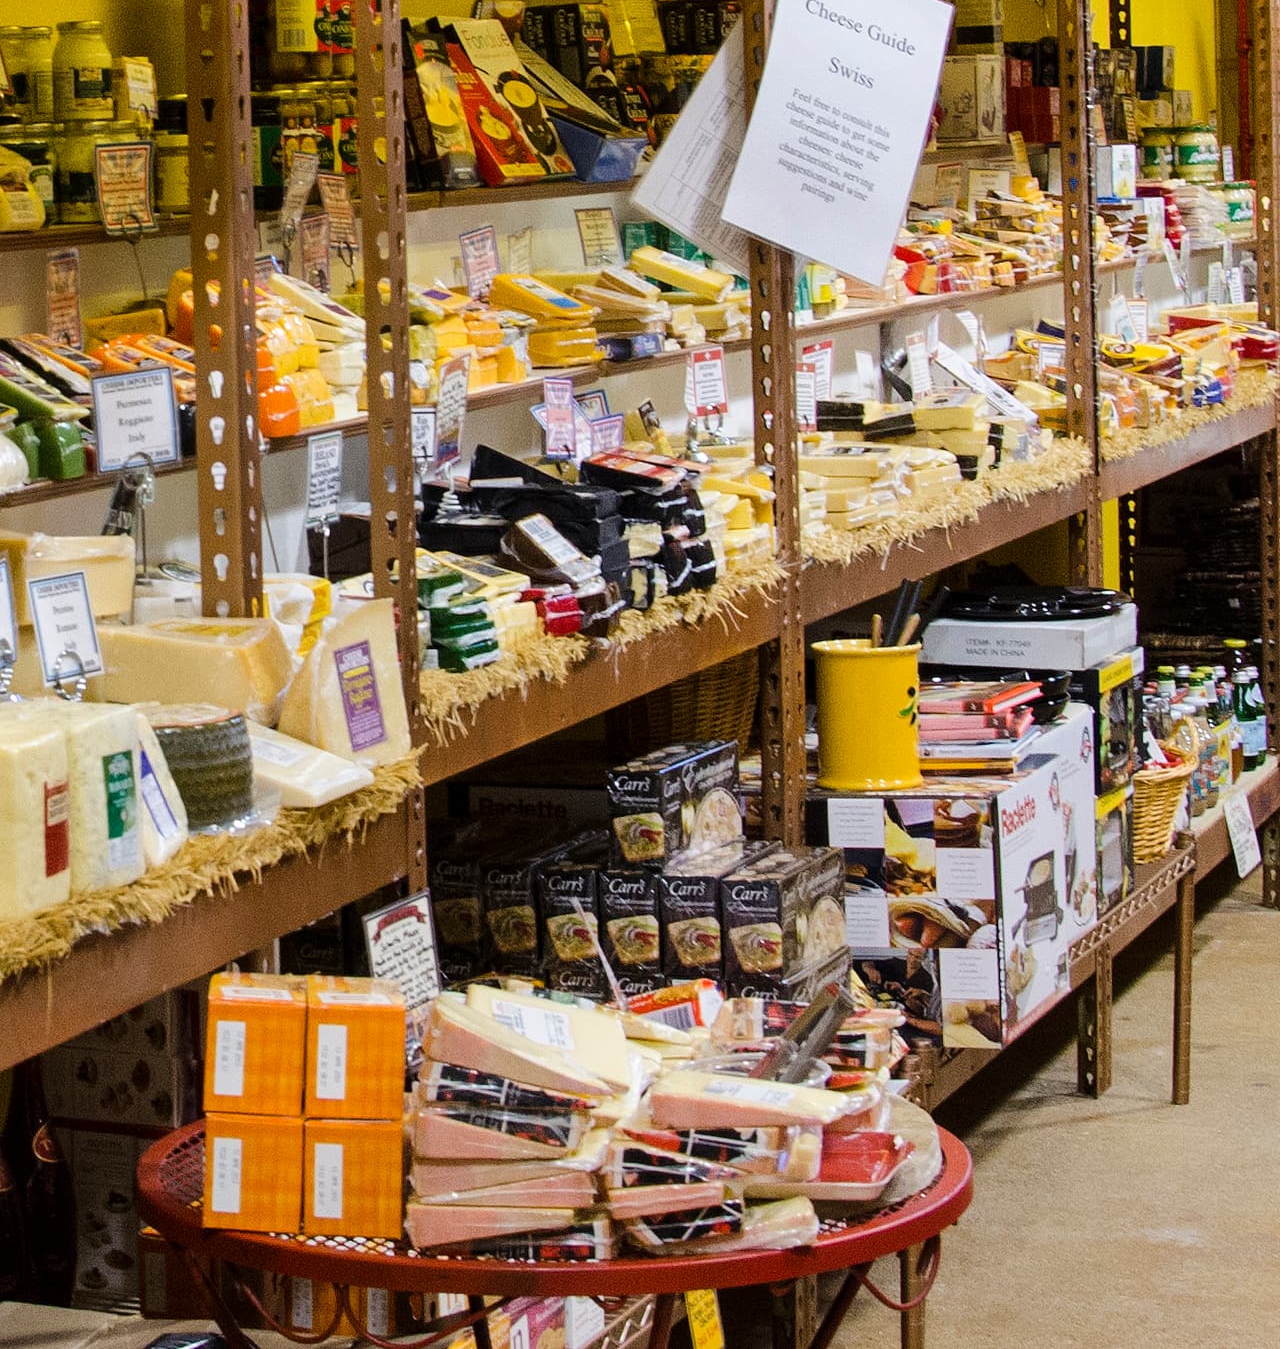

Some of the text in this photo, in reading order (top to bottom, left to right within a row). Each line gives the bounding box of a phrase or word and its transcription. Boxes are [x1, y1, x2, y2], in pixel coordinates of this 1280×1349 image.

[462, 27, 509, 50] Fondue
[868, 23, 917, 57] Guide
[828, 57, 875, 90] Swiss
[793, 88, 891, 138] Feel free to consult this
[785, 101, 891, 152] cheese guide to get some
[789, 117, 880, 163] information about the
[835, 152, 864, 170] cheese
[777, 157, 869, 201] suggestions and wine
[843, 170, 875, 192] serving
[800, 182, 836, 203] pairings
[126, 375, 164, 388] IMPORTERS
[116, 397, 153, 410] Parmesan
[128, 431, 146, 443] Italy
[1000, 649, 1026, 657] CHINA
[616, 776, 651, 793] Carr's
[664, 776, 682, 799] Carr's
[477, 797, 568, 821] Raclette
[1001, 794, 1037, 838] Raclette
[547, 875, 584, 894] Carr's
[608, 878, 646, 896] Carr's
[669, 880, 707, 898] Carr's
[731, 884, 771, 902] Carr's
[558, 970, 597, 988] Carr's
[619, 976, 656, 994] Carr's
[740, 985, 780, 1000] Carr's
